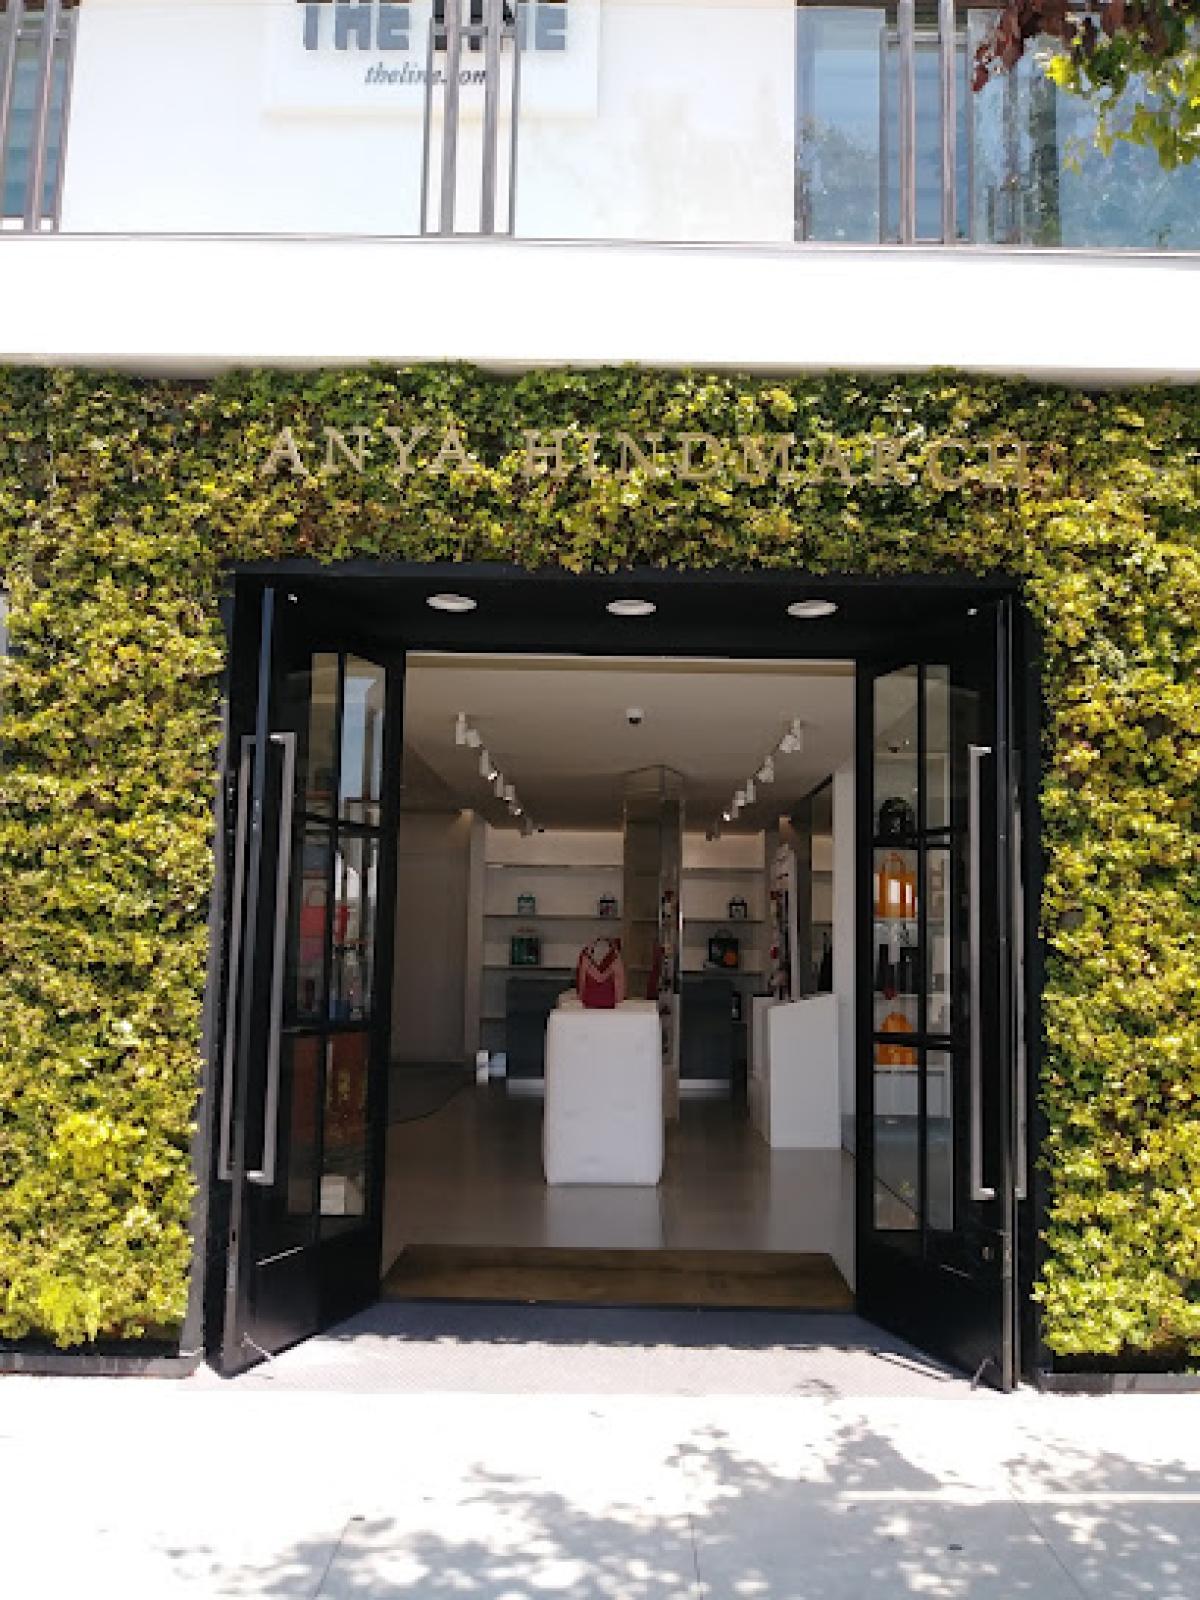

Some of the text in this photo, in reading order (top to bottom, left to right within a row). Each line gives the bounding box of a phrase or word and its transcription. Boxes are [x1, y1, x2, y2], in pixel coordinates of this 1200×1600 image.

[297, 0, 411, 51] THE
[364, 61, 488, 85] theline.om
[259, 425, 1030, 492] ANYA HINDMARCH
